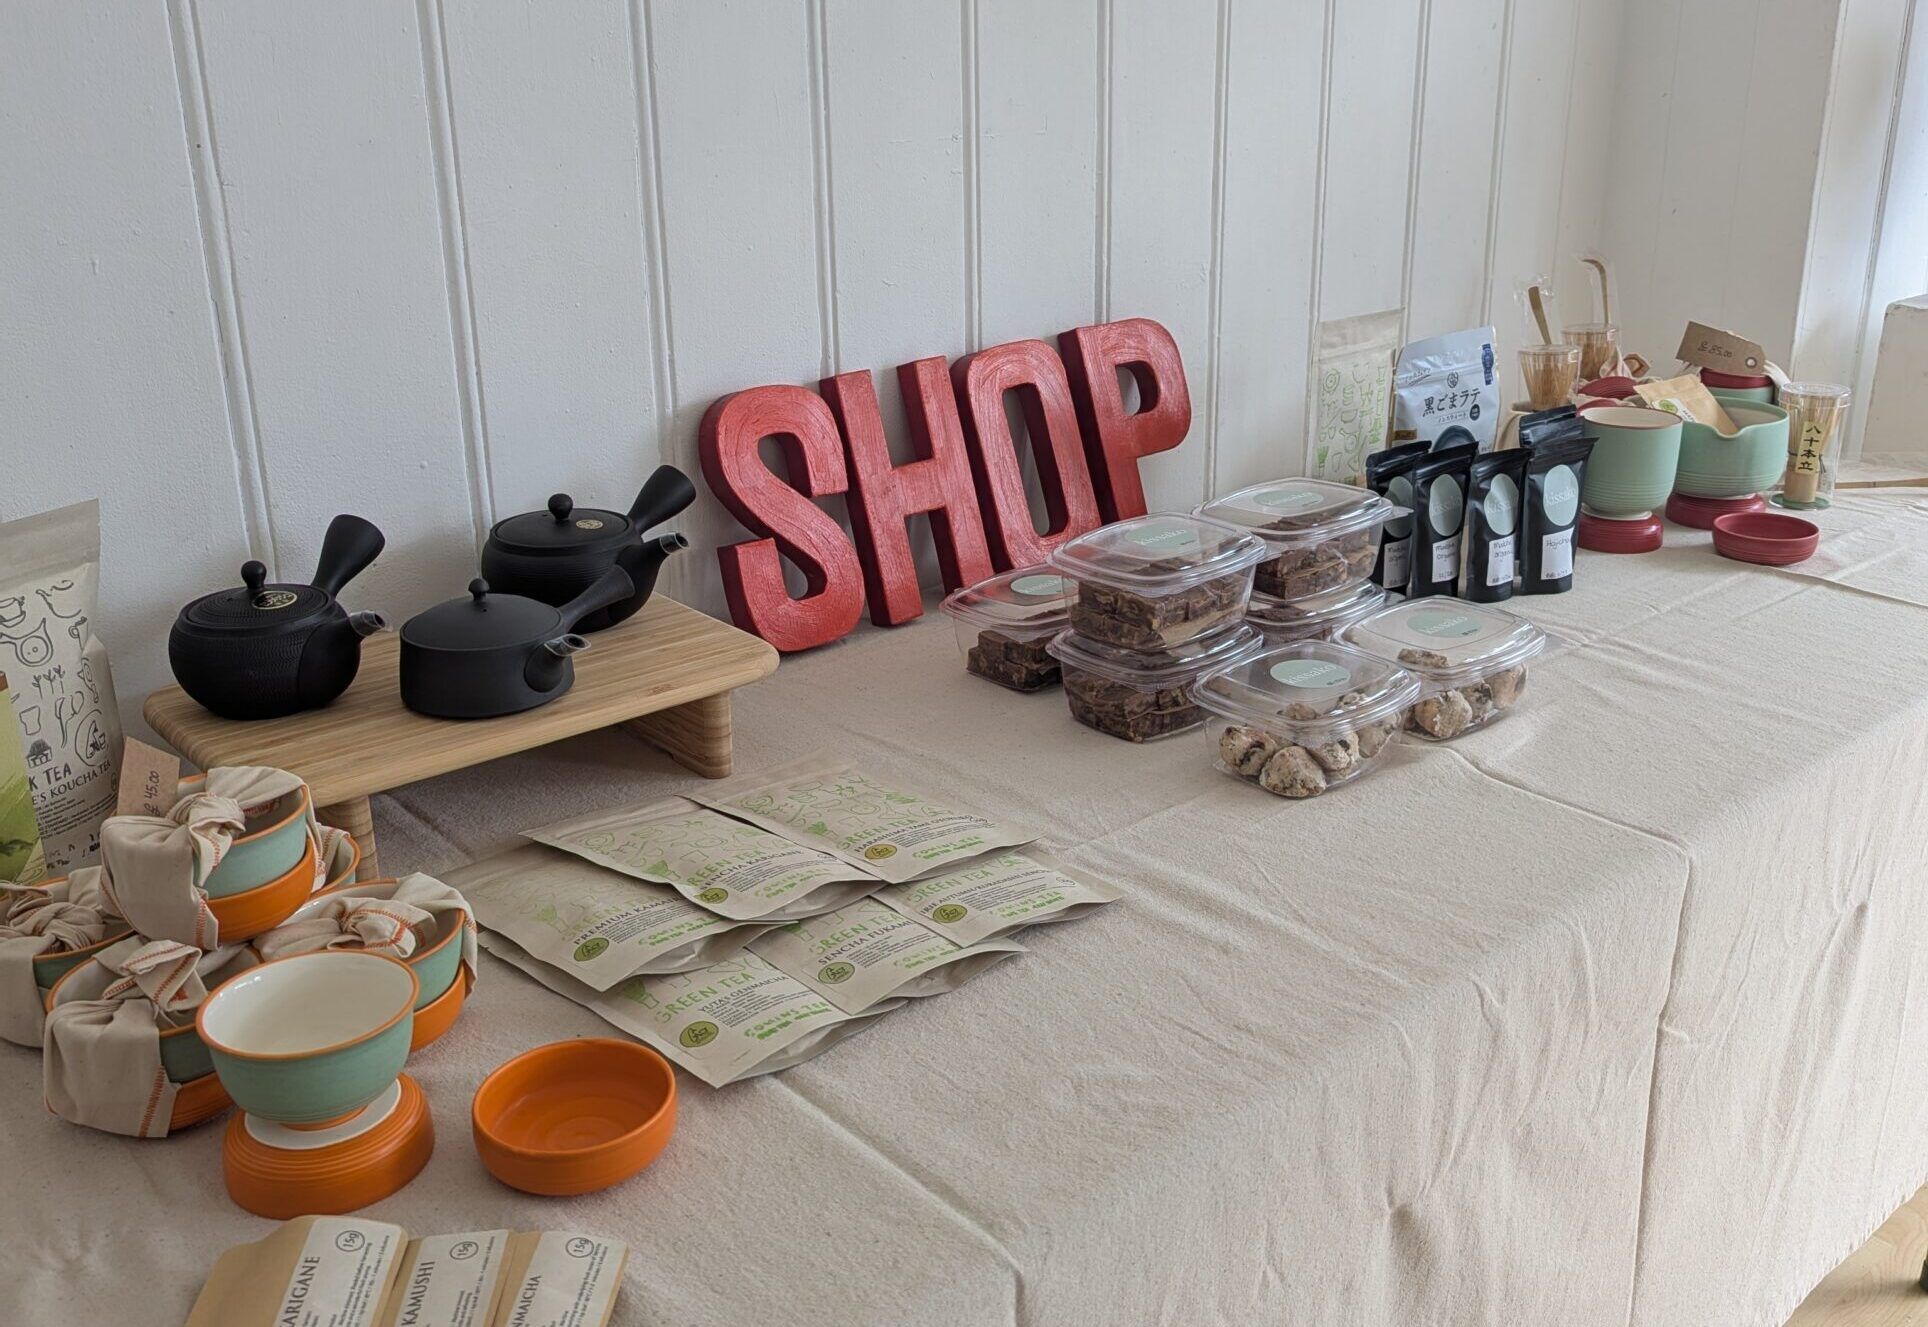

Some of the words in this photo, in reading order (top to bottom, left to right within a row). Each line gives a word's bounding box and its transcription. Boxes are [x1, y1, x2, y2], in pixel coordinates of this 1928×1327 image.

[1423, 388, 1481, 417] 黒ごまラテ
[1797, 424, 1822, 472] 八十本立
[700, 317, 1192, 652] SHOP
[28, 776, 38, 792] K
[43, 762, 72, 786] TEA
[50, 771, 99, 799] KOUCHA
[143, 770, 161, 799] 45.00
[686, 859, 732, 887] REEN
[962, 869, 994, 882] TEA
[573, 911, 633, 945] PREMIUM
[818, 937, 868, 966] SENCHA
[655, 985, 718, 1024] GREEN
[718, 971, 754, 988] TEA
[732, 975, 789, 1000] GENMAICHA
[342, 1233, 361, 1248] 15g
[457, 1243, 473, 1256] 15g
[573, 1239, 590, 1253] 15g
[279, 1256, 321, 1327] ARIGANE
[401, 1261, 436, 1326] KAMUSHI
